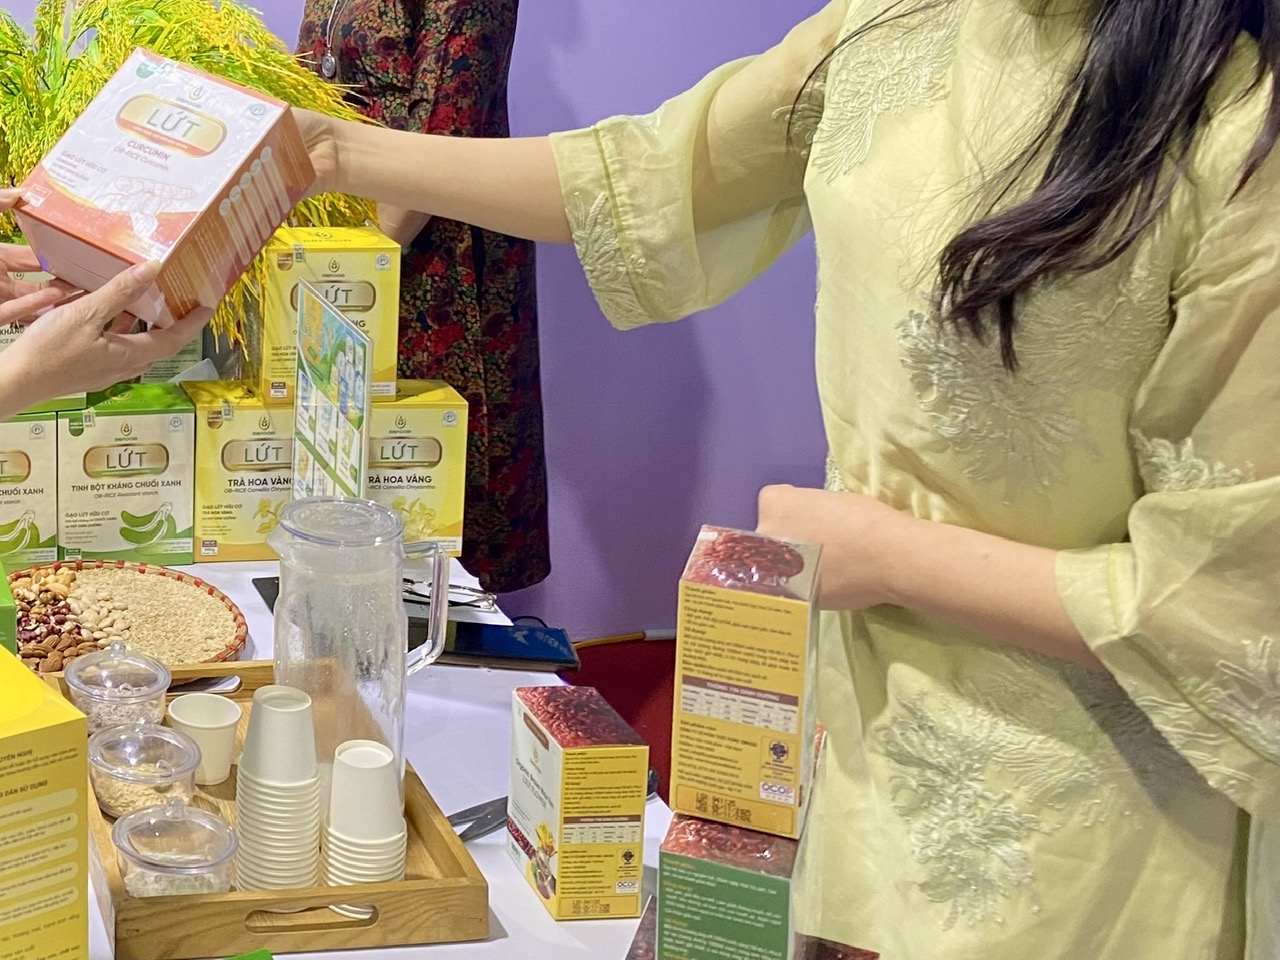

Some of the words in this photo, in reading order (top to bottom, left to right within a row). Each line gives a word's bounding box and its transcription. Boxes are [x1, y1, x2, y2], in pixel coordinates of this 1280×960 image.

[145, 109, 201, 138] LỨT
[127, 140, 170, 161] CURCUMIN
[106, 448, 147, 469] LỨT
[244, 443, 283, 463] LỨT
[380, 441, 419, 460] LỨT
[71, 484, 89, 492] TINH
[90, 483, 105, 493] BỘT
[107, 481, 133, 490] KHÁNG
[135, 479, 159, 488] CHUỐI
[227, 477, 245, 487] TRÀ
[248, 478, 269, 486] HOA
[406, 474, 432, 483] VÀNG
